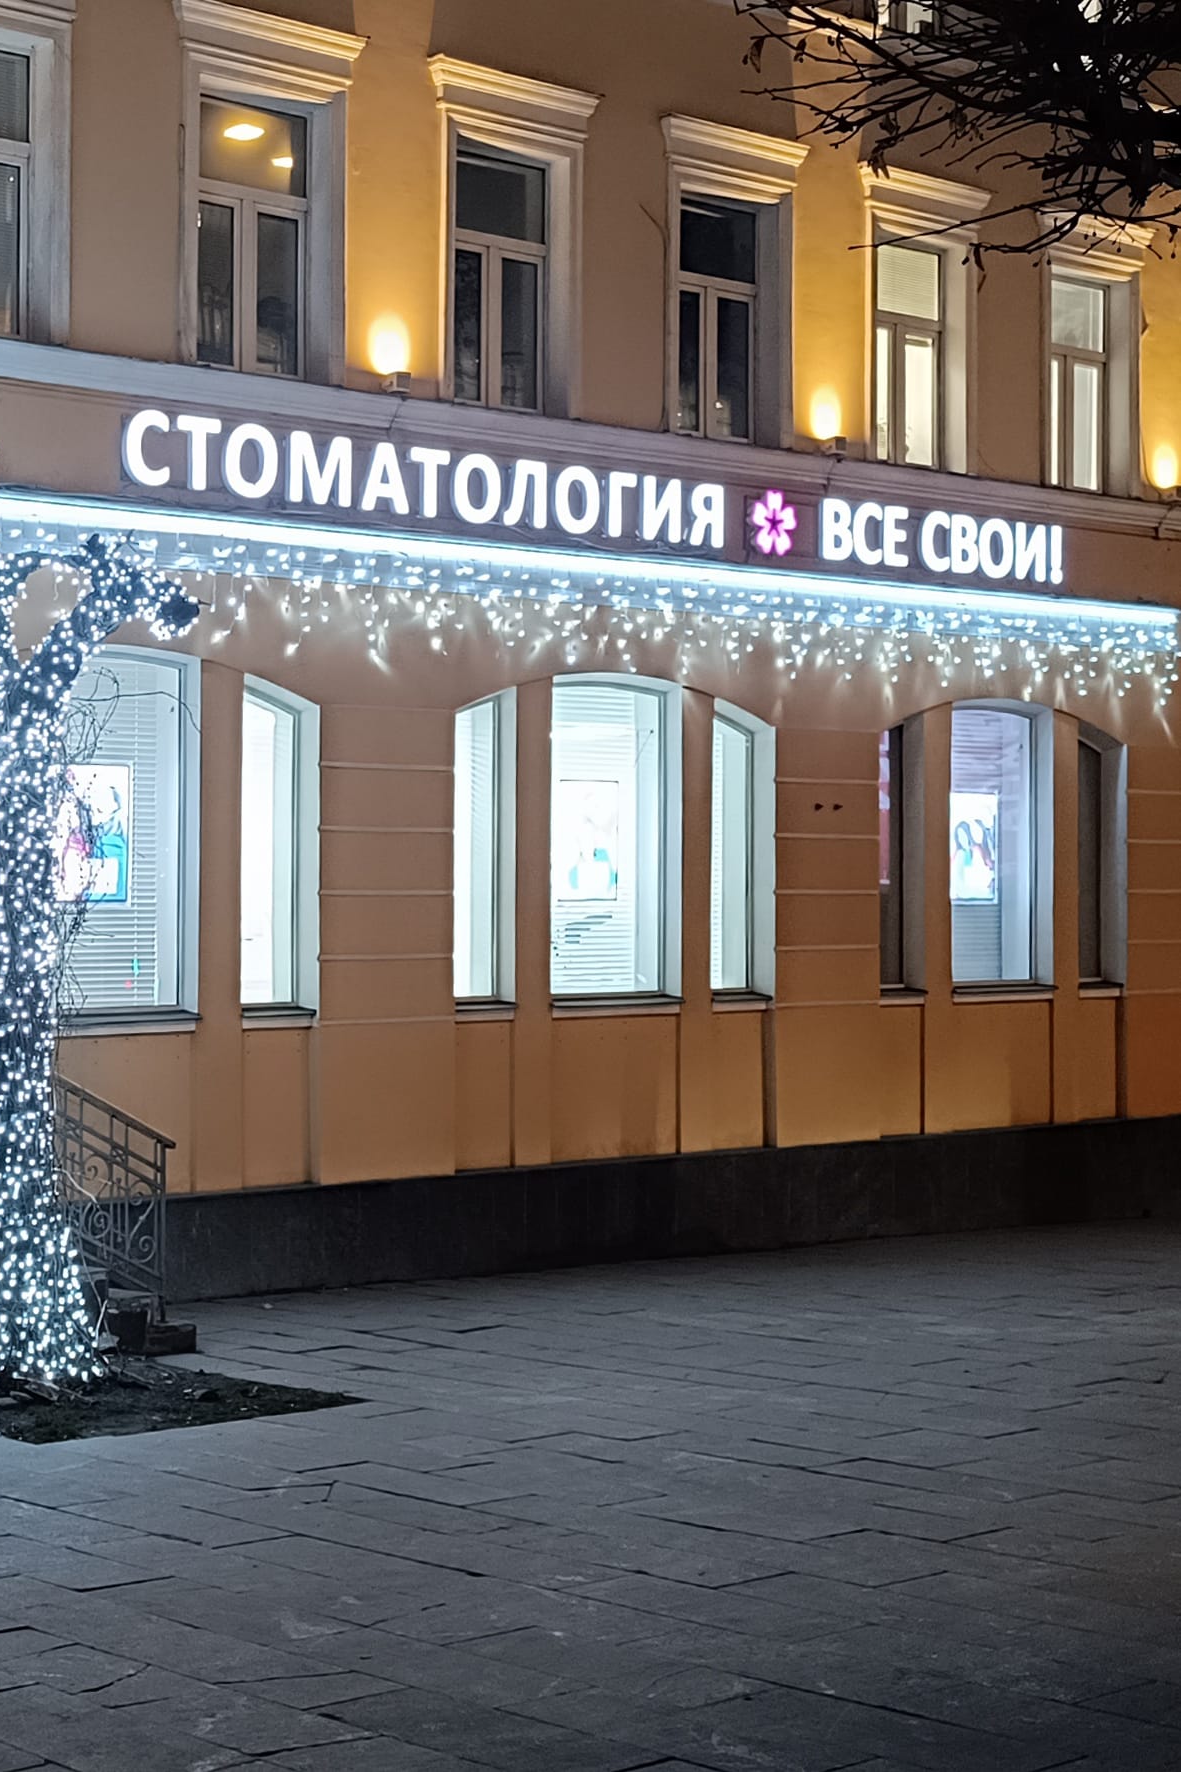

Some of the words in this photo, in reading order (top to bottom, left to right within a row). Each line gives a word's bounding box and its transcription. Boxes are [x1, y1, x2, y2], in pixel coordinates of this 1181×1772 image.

[125, 409, 726, 549] СТОМАТОЛОГИЯ
[822, 498, 909, 567] ВСЕ
[921, 510, 1064, 585] СВОИ!
